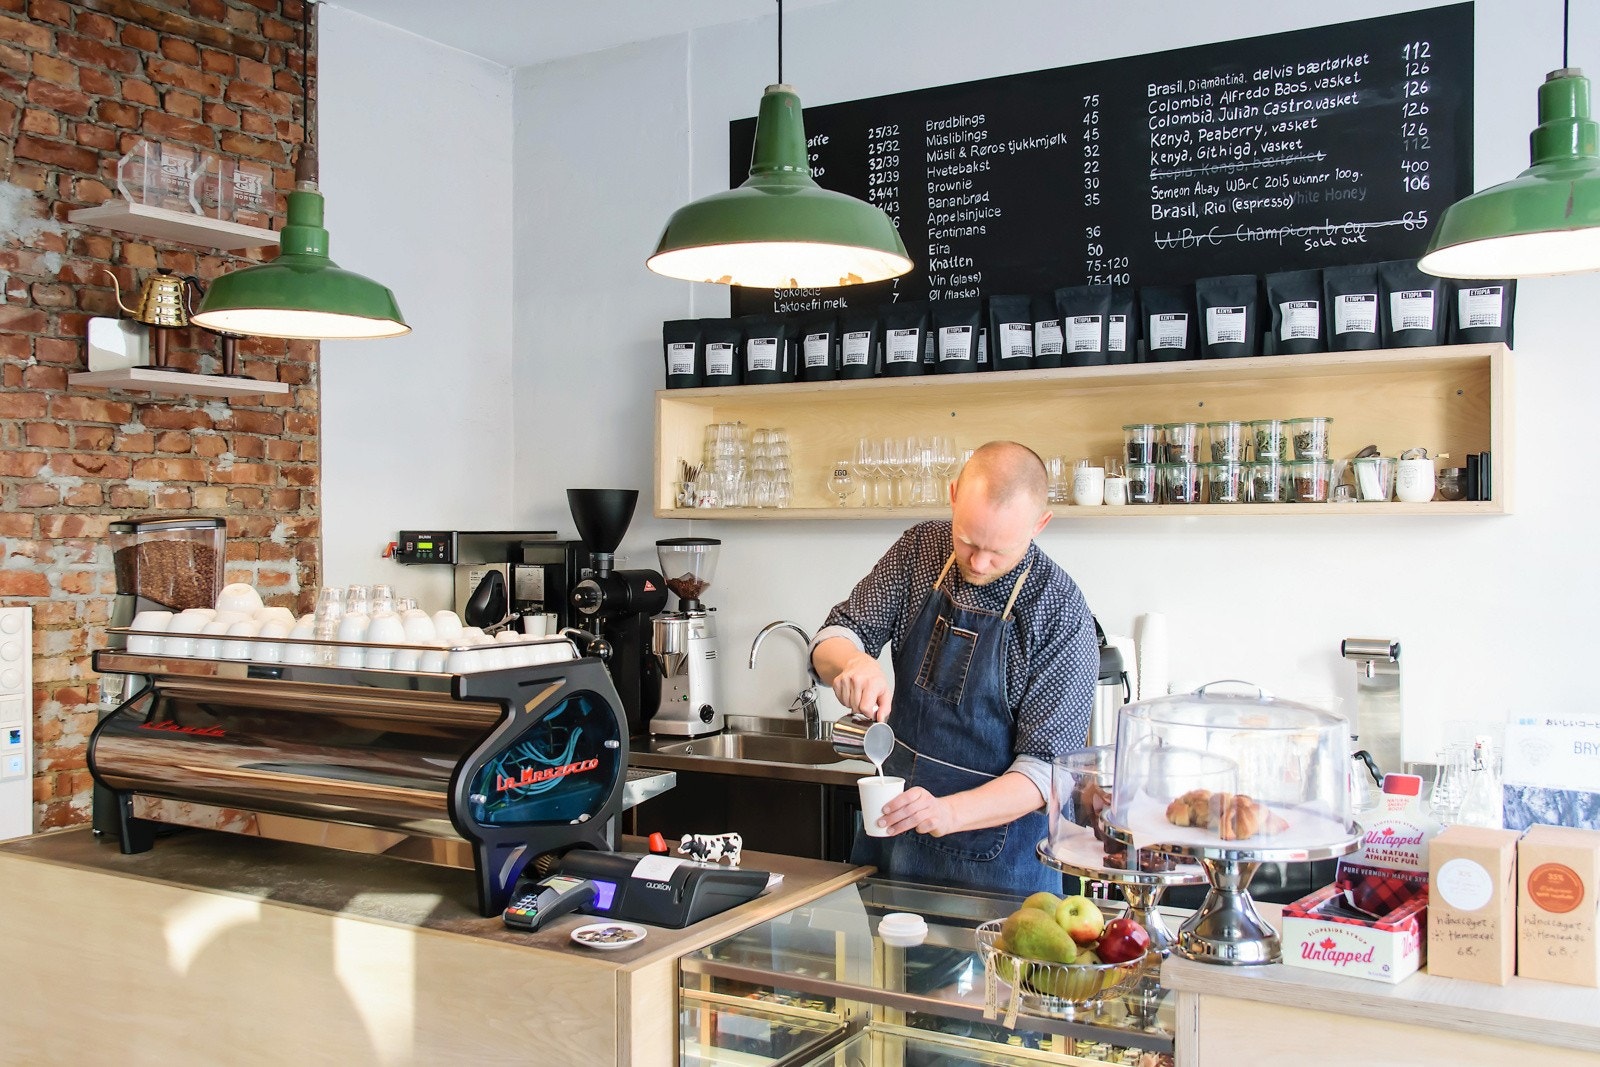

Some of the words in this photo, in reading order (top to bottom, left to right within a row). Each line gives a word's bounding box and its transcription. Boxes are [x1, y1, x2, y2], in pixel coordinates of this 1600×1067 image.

[1252, 65, 1293, 81] delvis
[1297, 53, 1370, 75] bærtørket
[1403, 41, 1431, 60] 112
[1219, 86, 1270, 105] Alfredo
[1314, 71, 1362, 89] vasket
[1405, 62, 1430, 77] 126
[1083, 95, 1099, 107] 75
[1218, 104, 1259, 122] Julian
[1404, 81, 1429, 98] 126
[926, 114, 985, 132] Brødblings
[1083, 111, 1099, 125] 45
[1150, 130, 1193, 148] Kenya,
[1198, 124, 1268, 141] Peaberry,
[1272, 117, 1318, 133] vasket
[1402, 102, 1429, 118] 126
[868, 125, 900, 139] 25/32
[926, 129, 988, 147] Müsliblings
[1083, 128, 1100, 141] 45
[868, 140, 900, 155] 25/32
[926, 147, 956, 163] Müsli
[958, 147, 967, 159] &
[970, 142, 1005, 157] Røros
[1007, 133, 1068, 155] tjukkmjølk
[1084, 145, 1100, 157] 32
[1150, 147, 1192, 166] Kenya,
[1197, 141, 1257, 160] Githiga,
[1260, 138, 1303, 154] vasket
[1401, 122, 1428, 138] 126
[1403, 136, 1431, 152] 112
[868, 155, 900, 170] 32/39
[927, 159, 991, 179] Hvetebakst
[1084, 161, 1100, 174] 22
[868, 171, 900, 186] 32/39
[927, 178, 973, 194] Brownie
[1084, 177, 1100, 189] 30
[1151, 184, 1190, 200] Semeon
[1226, 177, 1259, 193] WBrC
[1264, 173, 1290, 189] 2015
[1292, 172, 1330, 187] winner
[1401, 160, 1429, 174] 400
[868, 187, 899, 201] 34/41
[928, 191, 989, 209] Bananbrød
[1084, 193, 1100, 206] 35
[1151, 202, 1199, 221] Brasil,
[1204, 201, 1226, 216] Rio
[1232, 194, 1294, 214] (espresso)
[1325, 187, 1367, 202] Honey
[1403, 175, 1430, 193] 106
[927, 206, 1002, 226] Appelsinjuice
[1402, 210, 1428, 231] 85
[928, 225, 986, 240] Fentimans
[1086, 226, 1101, 239] 36
[929, 243, 950, 255] Eira
[1087, 243, 1103, 256] 50
[1304, 237, 1337, 252] Sold
[1341, 231, 1368, 245] out
[929, 256, 973, 272] Knatten
[1086, 257, 1129, 272] 75-120
[892, 278, 899, 289] 7
[928, 274, 946, 287] Vin
[950, 271, 982, 287] (glass)
[1086, 273, 1130, 287] 75-140
[824, 297, 848, 310] melk
[892, 293, 899, 304] 7
[1365, 831, 1424, 848] Untapped
[1365, 854, 1398, 863] ATHLETIC
[1401, 858, 1418, 866] FUEL
[1382, 849, 1419, 859] NATURAL
[1343, 866, 1359, 875] PURE
[1361, 868, 1390, 878] VERMONT
[1391, 872, 1412, 882] MAPLE
[1300, 941, 1375, 967] Untapped
